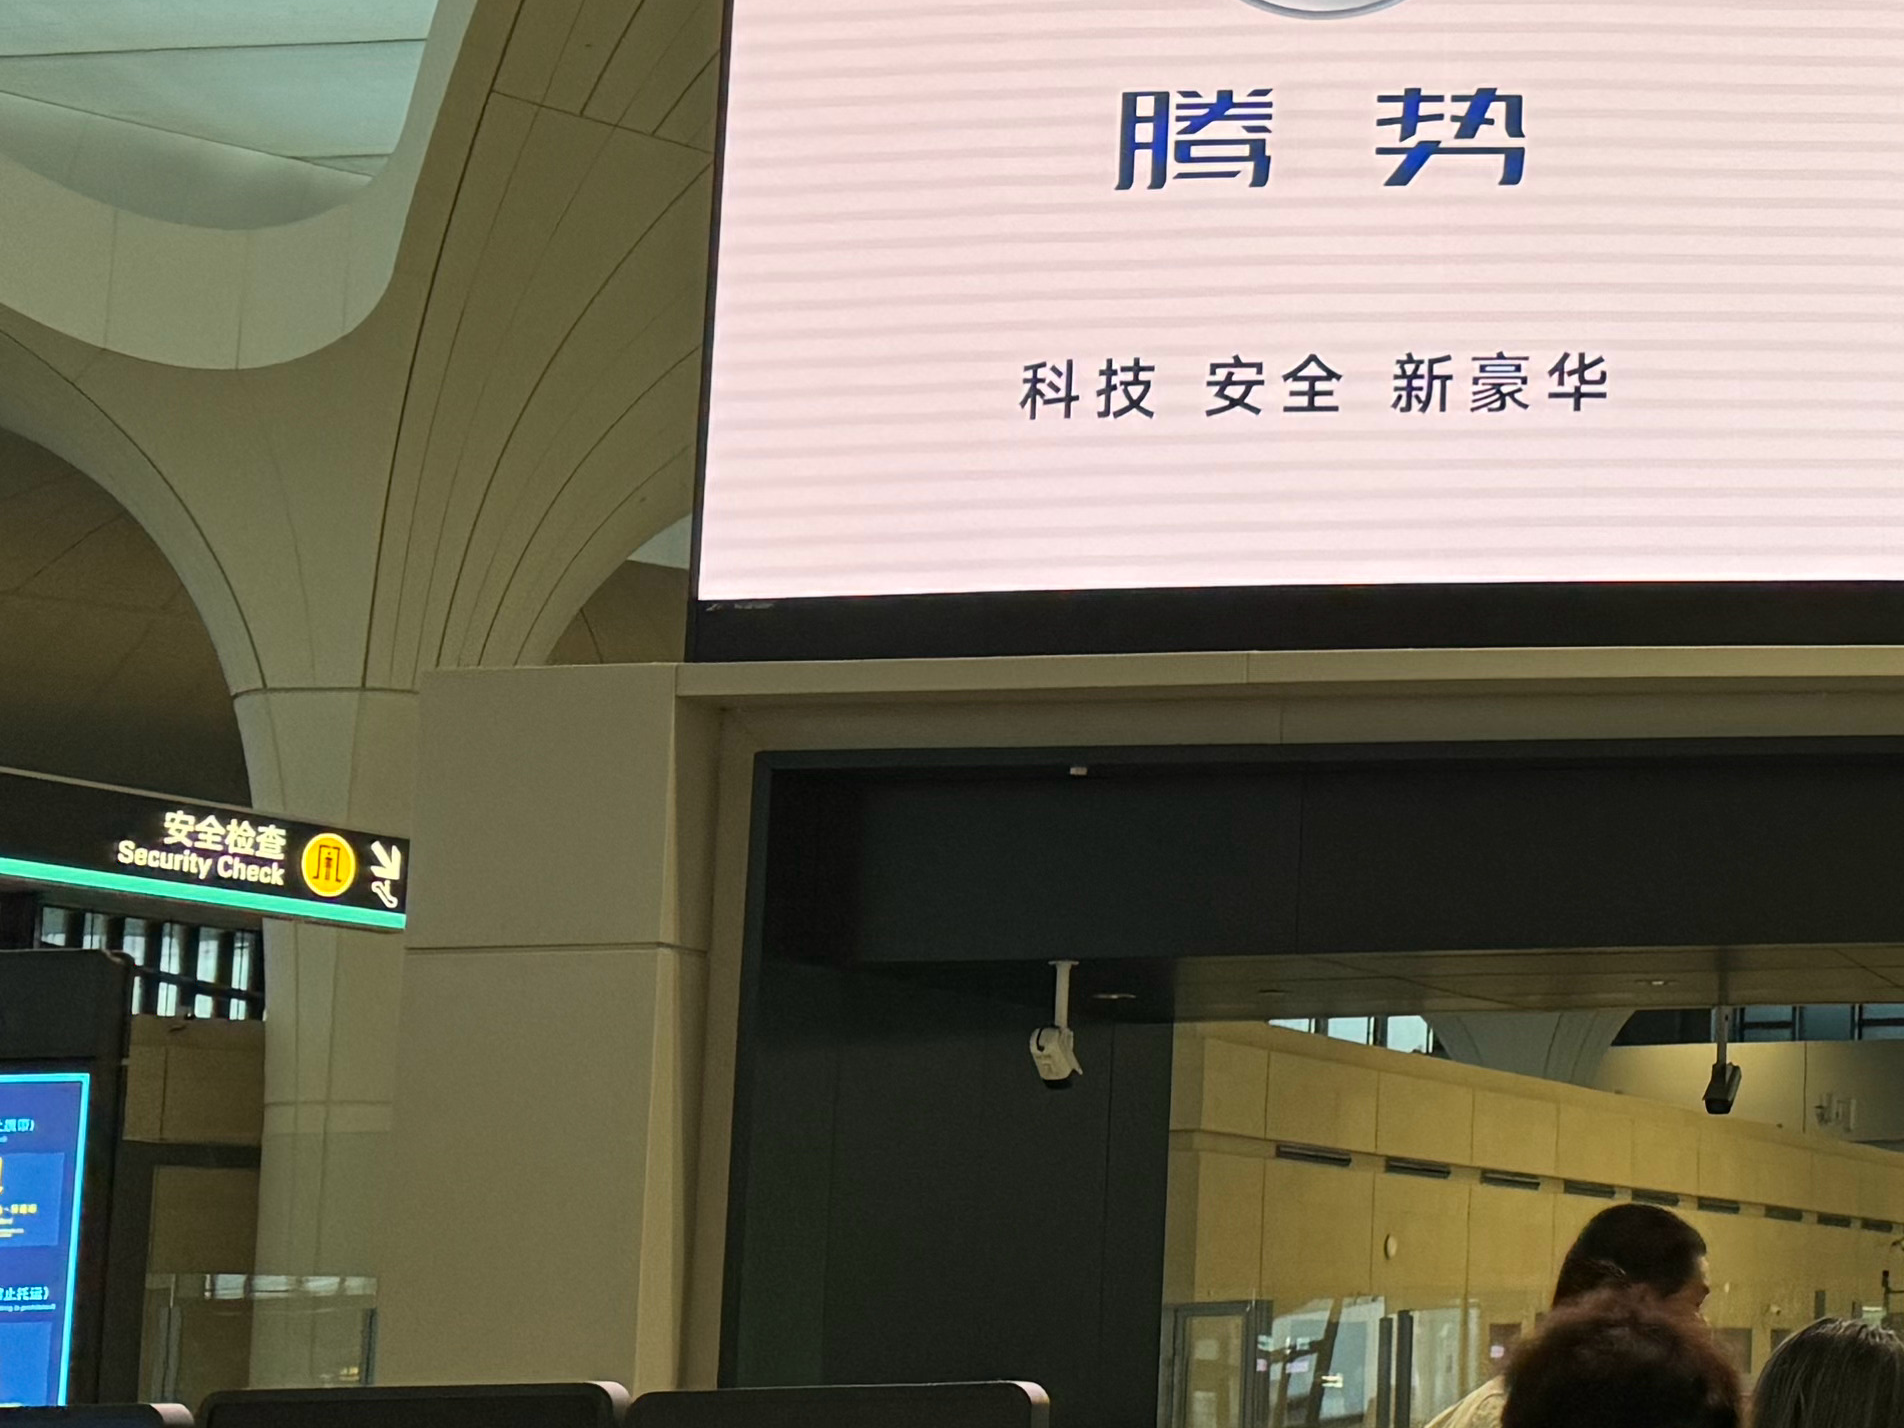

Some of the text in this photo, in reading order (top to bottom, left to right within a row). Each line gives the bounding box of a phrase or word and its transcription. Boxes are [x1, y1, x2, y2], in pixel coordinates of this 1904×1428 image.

[1113, 86, 1528, 191] 腾势
[1018, 350, 1610, 421] 科技 安全 新豪华
[117, 840, 285, 886] Security Check
[163, 810, 287, 860] 安全检查
